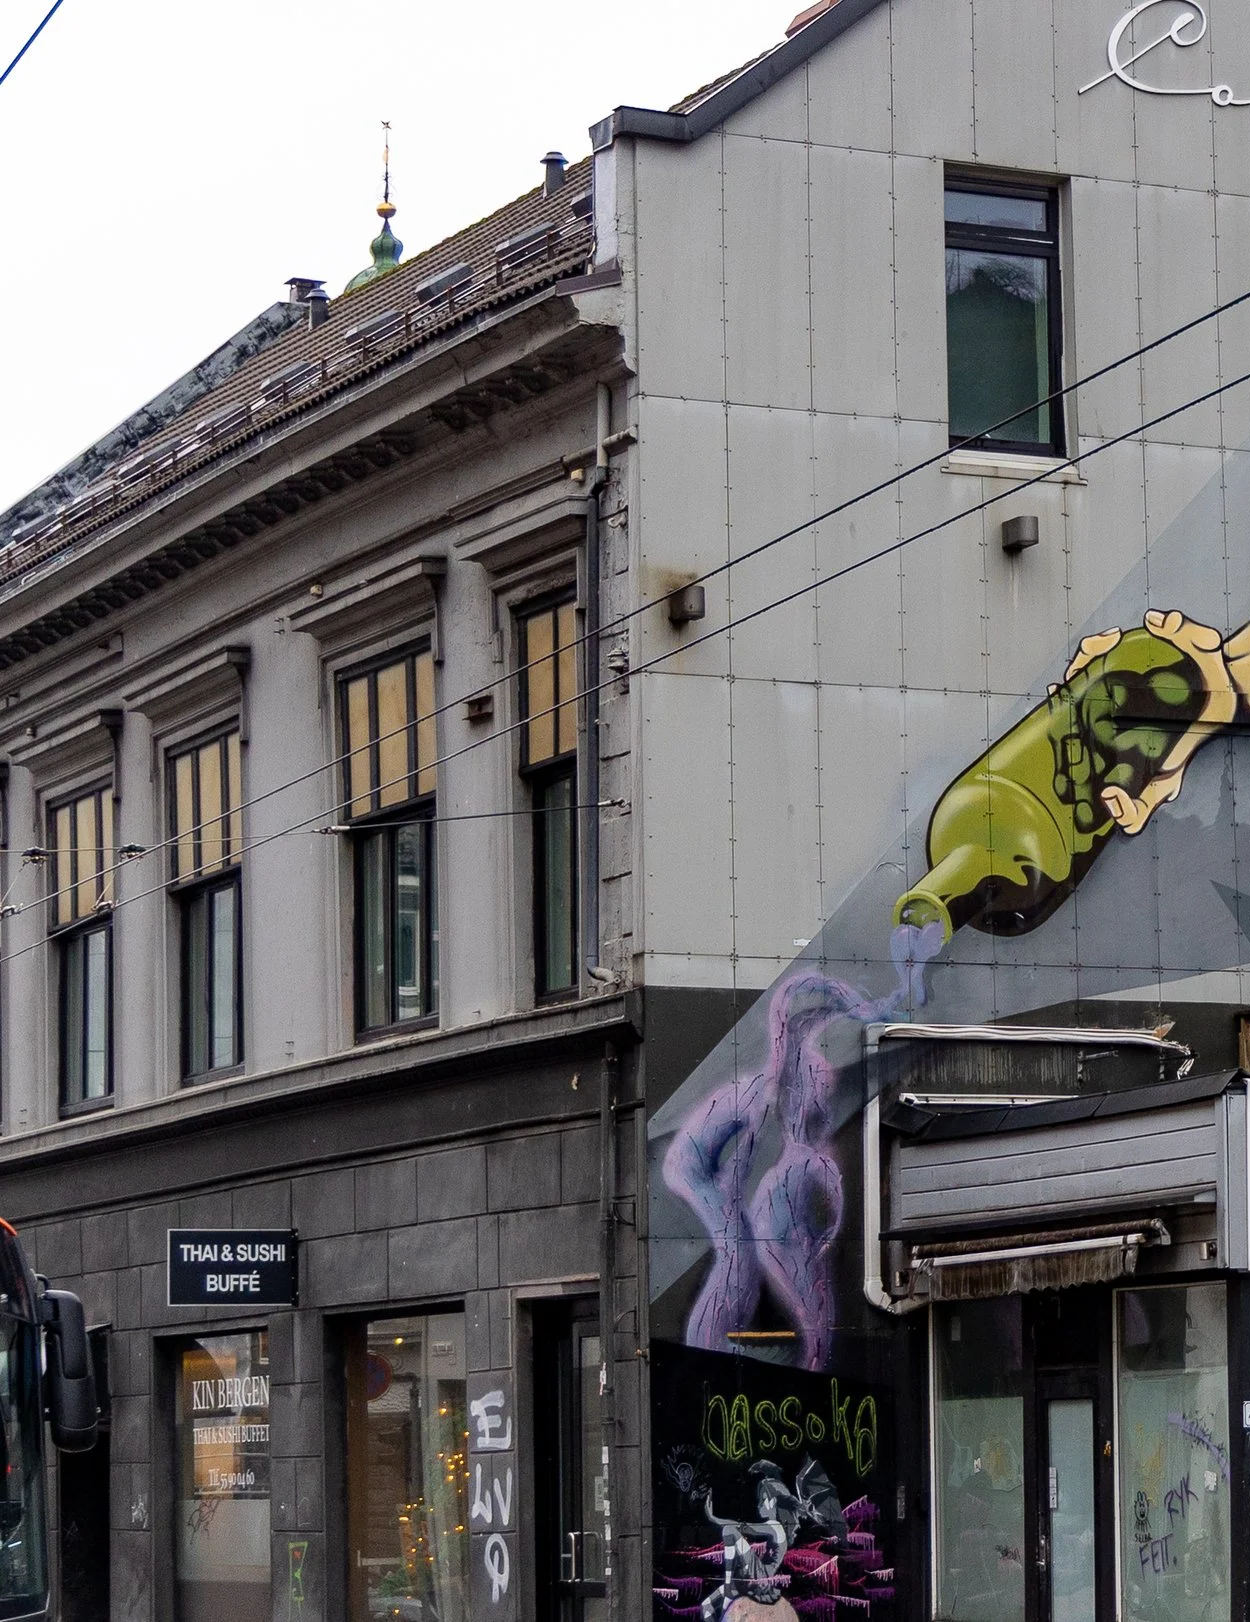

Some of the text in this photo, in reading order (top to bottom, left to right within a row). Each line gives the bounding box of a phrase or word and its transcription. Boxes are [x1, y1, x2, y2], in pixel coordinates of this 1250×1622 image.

[179, 1244, 286, 1262] THAI & SUSHI
[206, 1270, 261, 1292] BUFFÉ
[192, 1375, 270, 1410] KIN BERGEN
[193, 1427, 211, 1445] THAI
[218, 1425, 241, 1444] SUSHI
[241, 1424, 270, 1443] BUFFET
[220, 1472, 228, 1489] 55
[228, 1472, 236, 1489] 90
[236, 1472, 246, 1489] 04
[246, 1468, 255, 1485] 60
